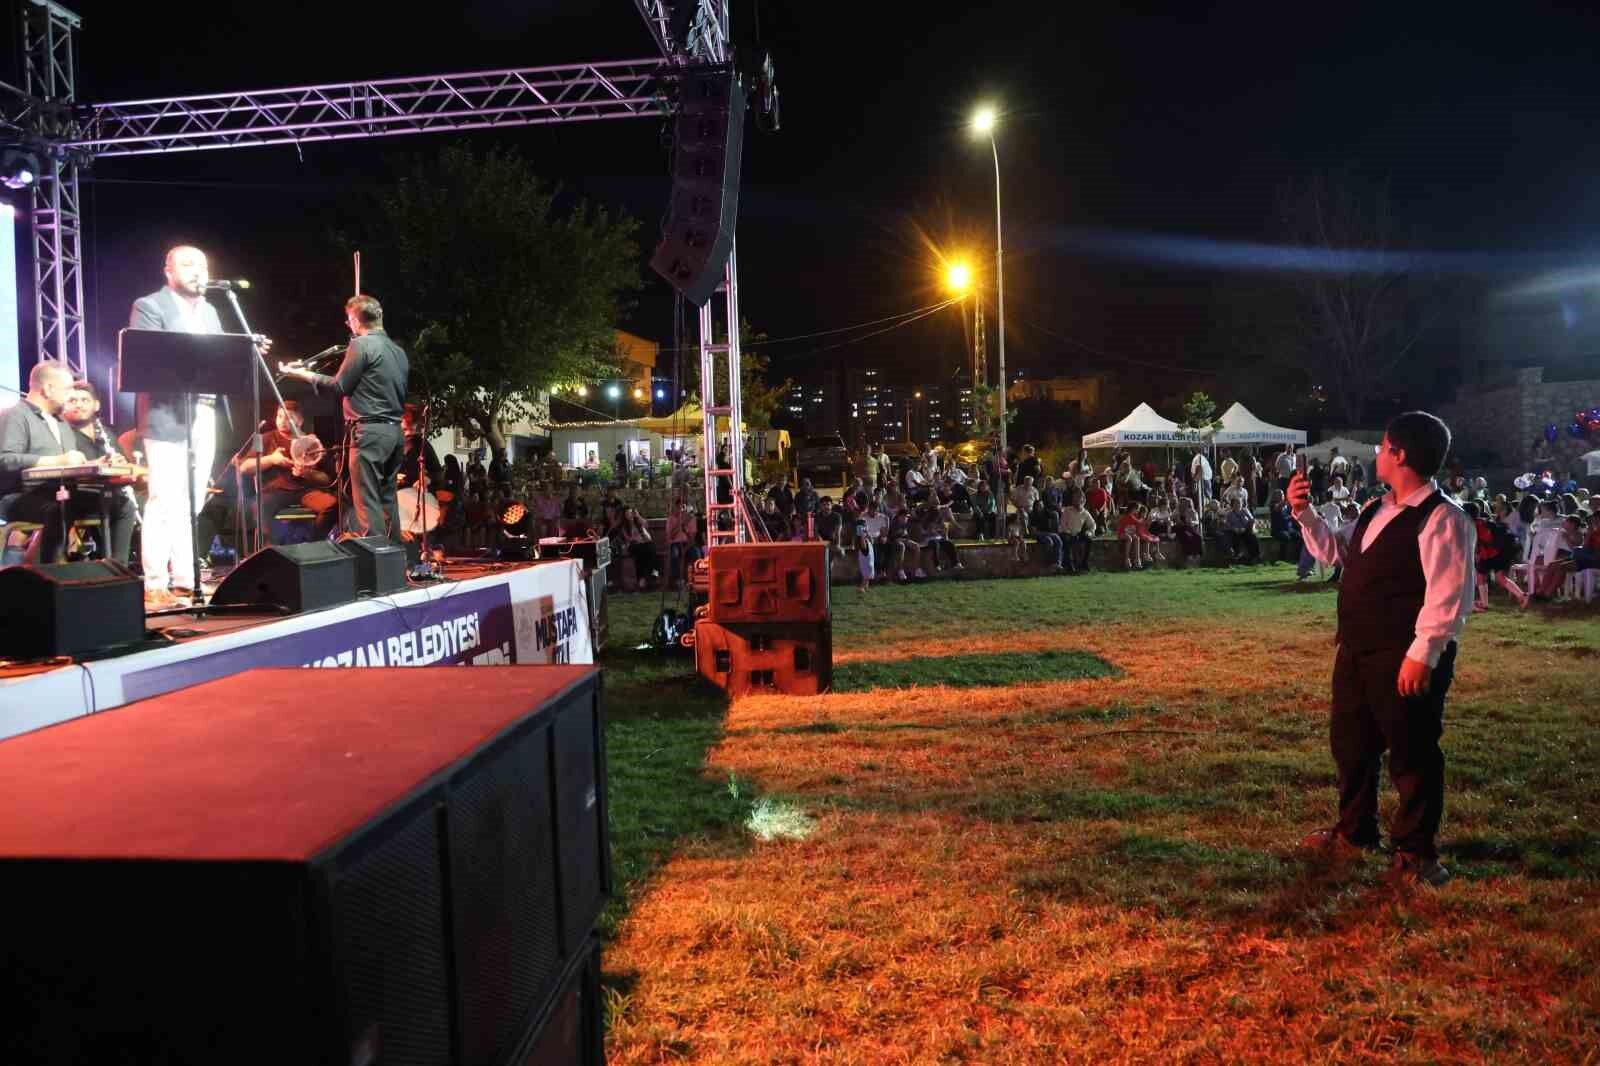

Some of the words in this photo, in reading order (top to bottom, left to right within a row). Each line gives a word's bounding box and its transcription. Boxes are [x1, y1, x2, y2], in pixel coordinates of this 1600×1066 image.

[1124, 432, 1153, 441] KOZAN
[535, 606, 578, 652] MUSTAFA
[302, 640, 385, 667] ZAN
